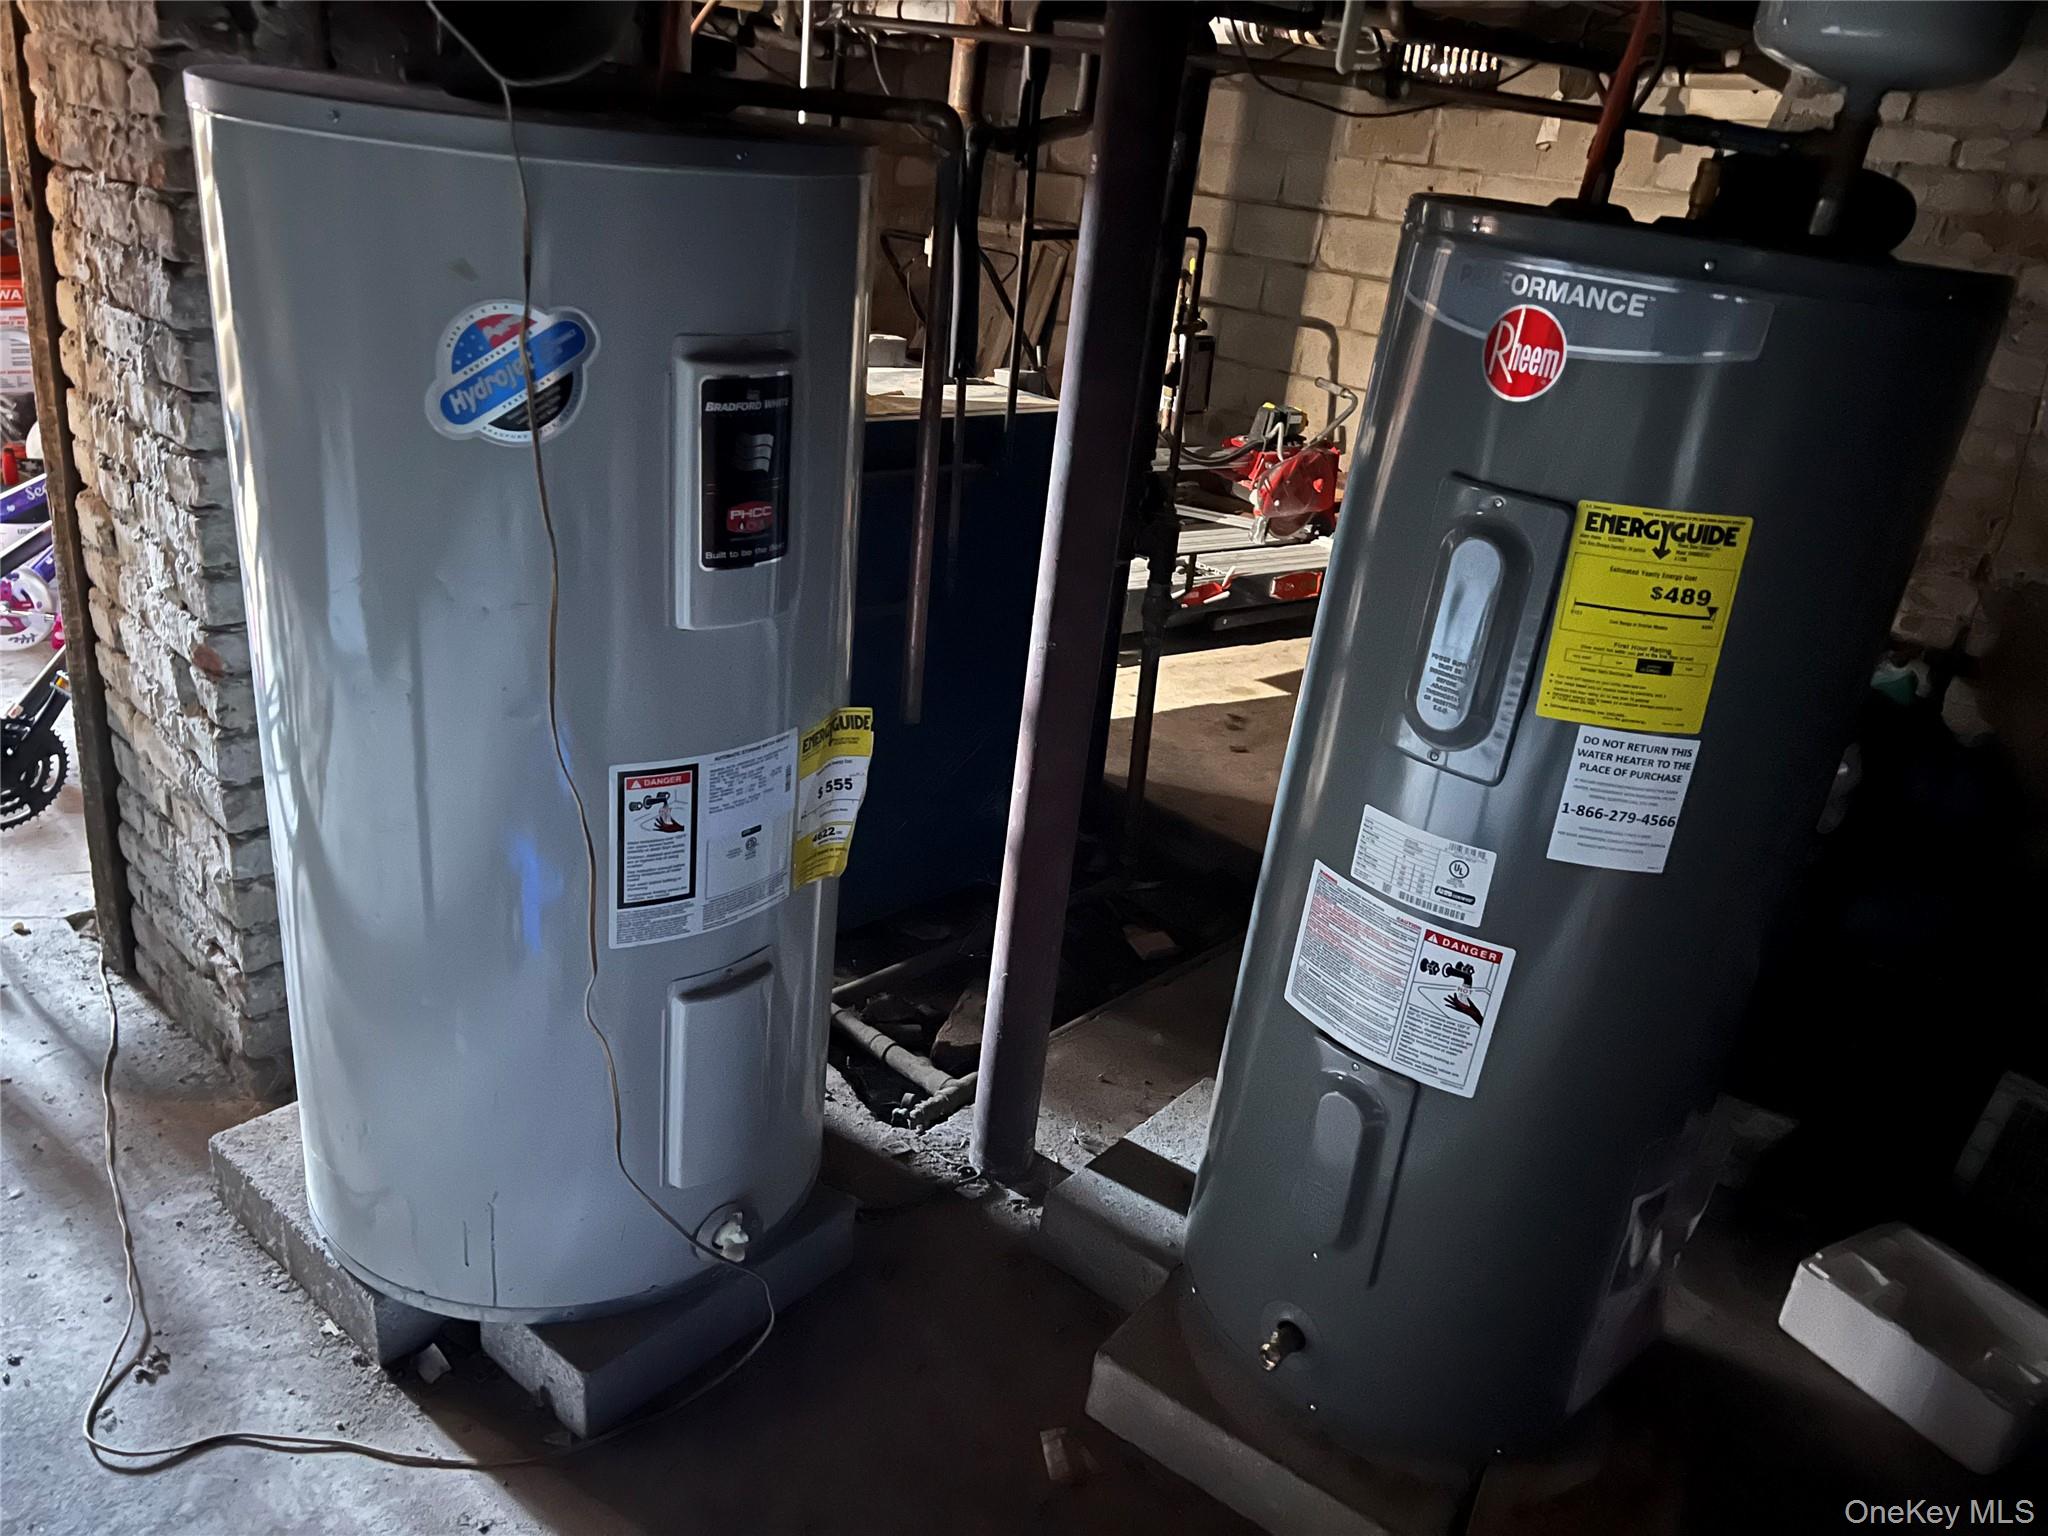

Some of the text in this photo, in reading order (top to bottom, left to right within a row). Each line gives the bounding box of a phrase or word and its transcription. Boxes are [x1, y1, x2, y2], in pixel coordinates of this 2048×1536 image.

[1459, 265, 1648, 318] PFORMANCE
[1488, 306, 1560, 384] Rheem
[704, 401, 762, 412] BRADFORD
[730, 506, 772, 520] PHCC
[1585, 511, 1740, 549] ENERGYGUIDE
[1650, 586, 1712, 606] $489
[1583, 735, 1693, 758] DO NOT RETURN THIS
[1577, 747, 1692, 771] WATER HEATER TO THE
[643, 775, 683, 787] DANGER
[1579, 762, 1683, 784] PLACE OF PURCHASE
[1561, 802, 1677, 828] 1-866-279-4566
[1454, 863, 1464, 876] UL
[1442, 938, 1498, 962] DANGER
[1457, 986, 1473, 995] HOT
